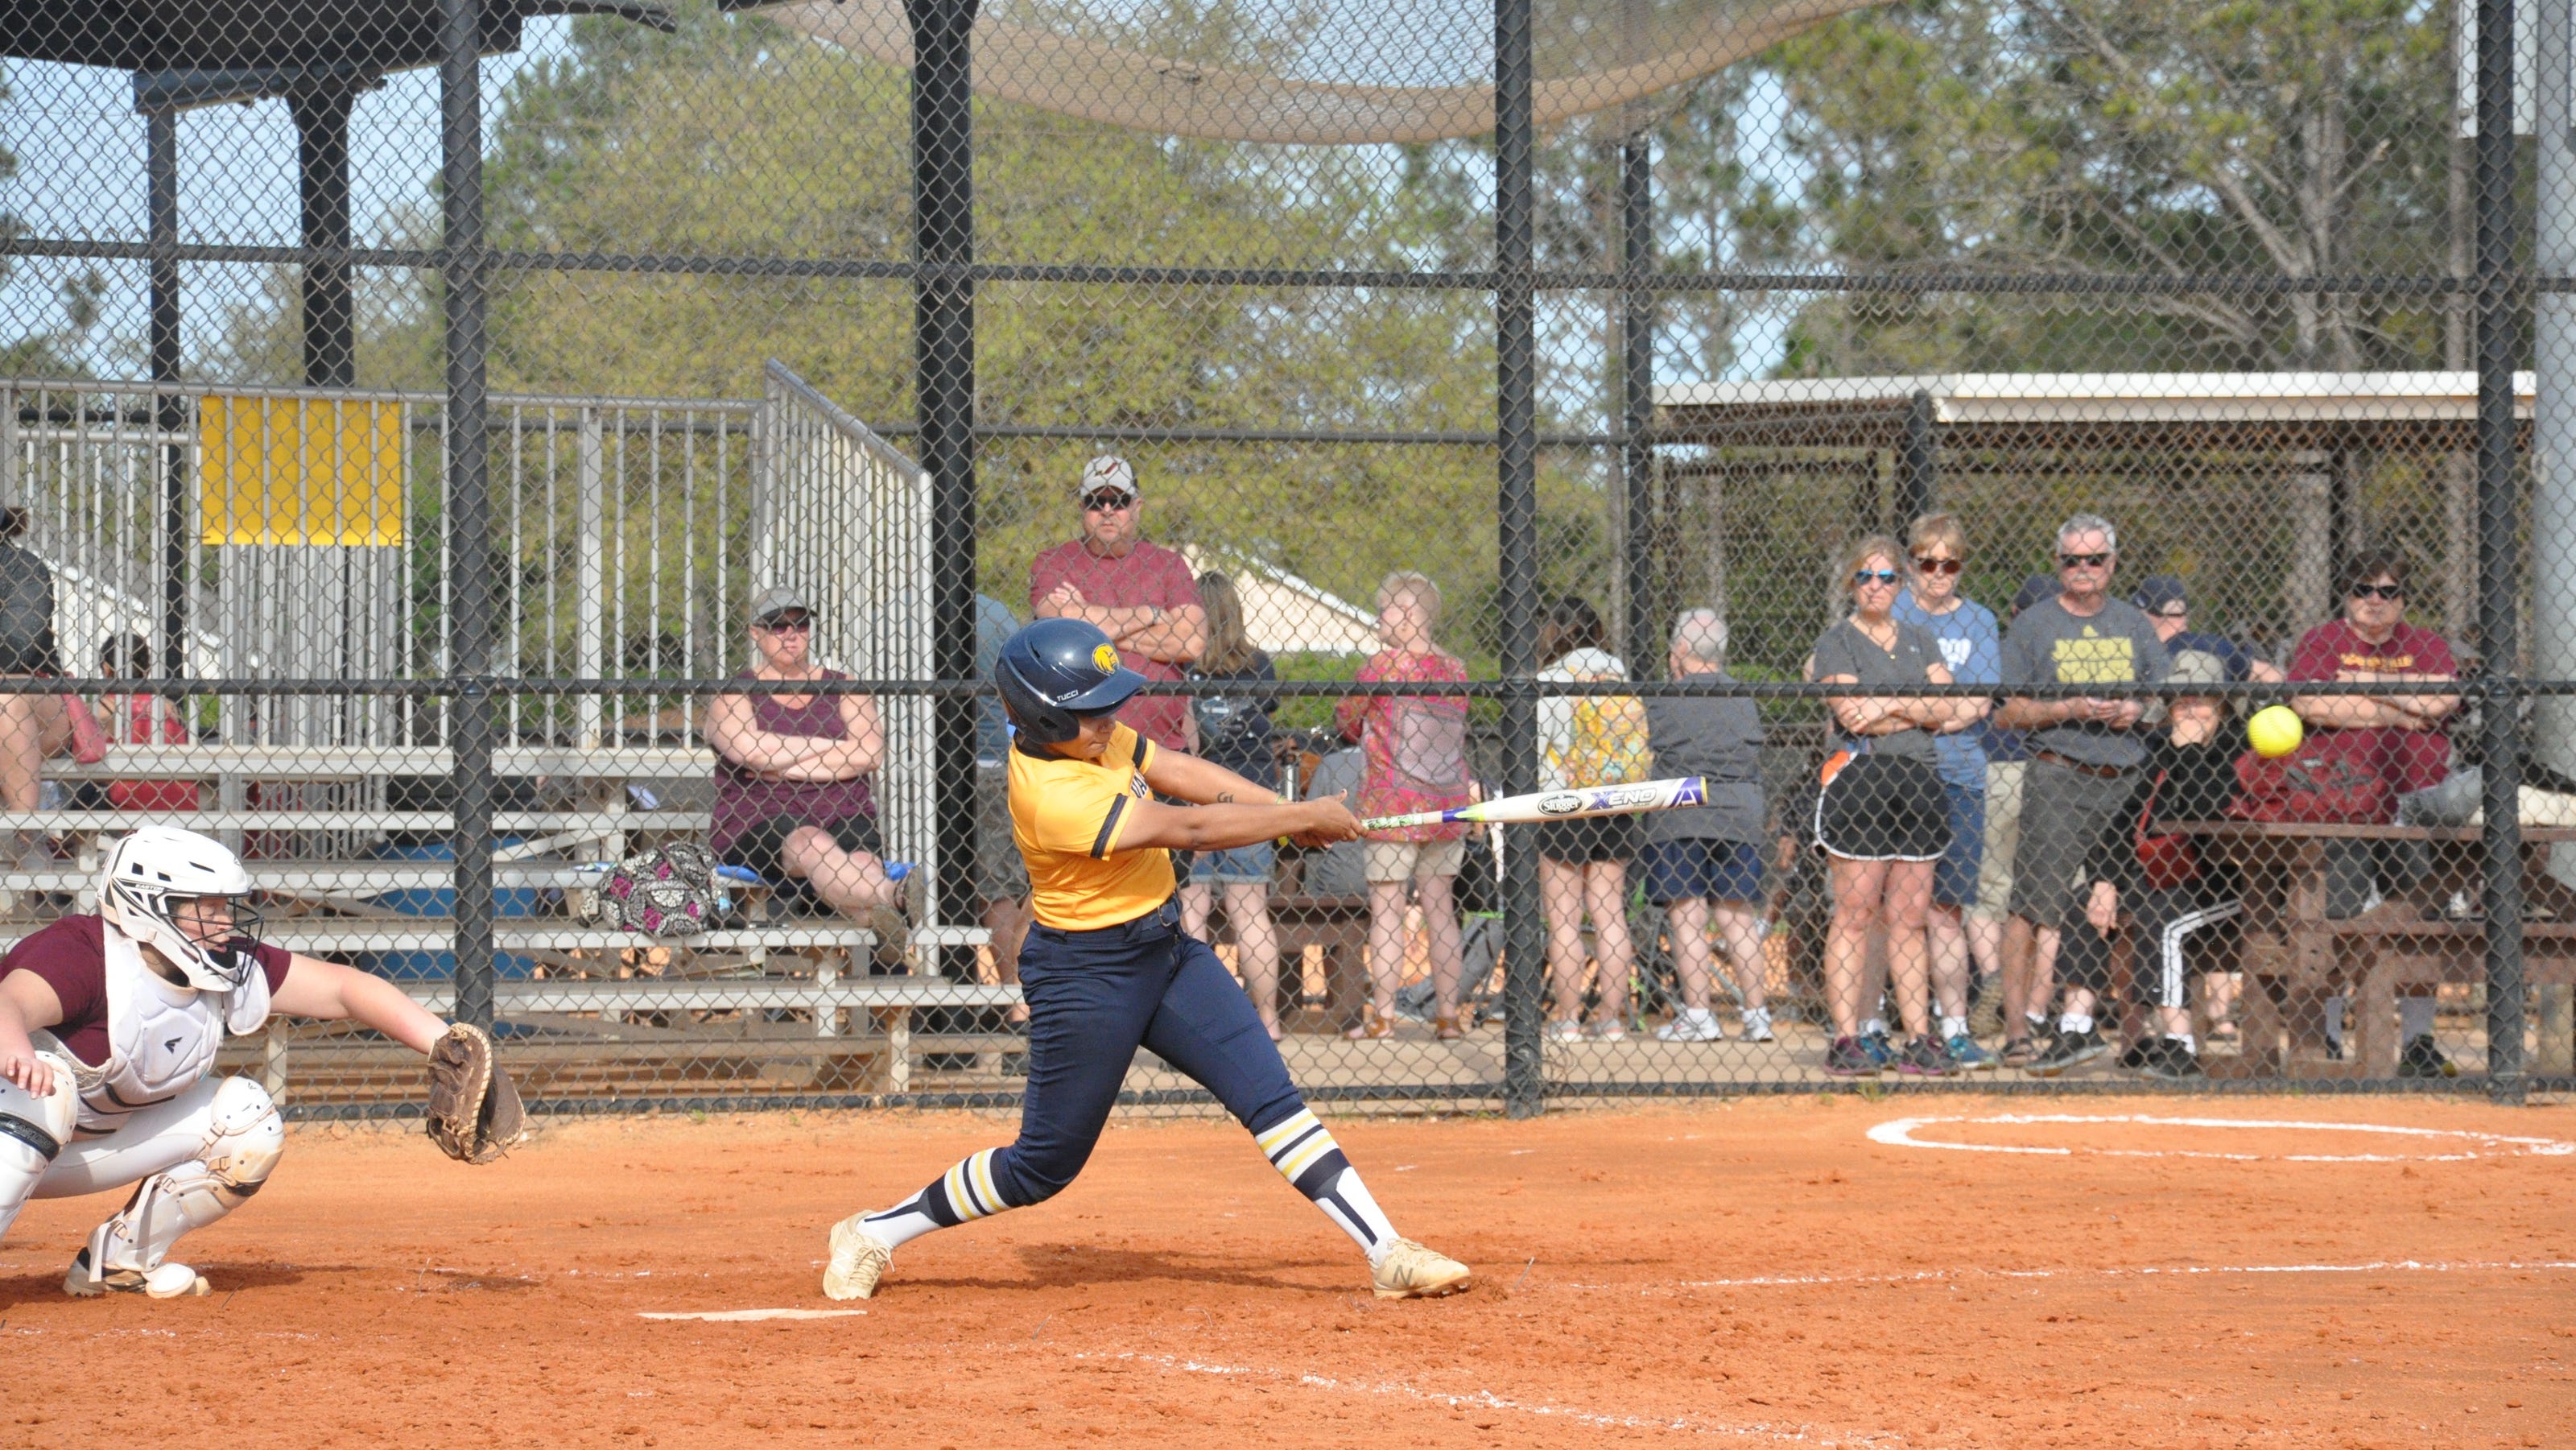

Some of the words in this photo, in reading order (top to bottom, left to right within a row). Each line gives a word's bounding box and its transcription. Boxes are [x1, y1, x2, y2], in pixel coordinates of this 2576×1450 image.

[1057, 689, 1079, 701] TUCCI
[1542, 799, 1579, 813] Slugger
[1585, 787, 1657, 811] XENO
[1392, 1264, 1414, 1287] N
